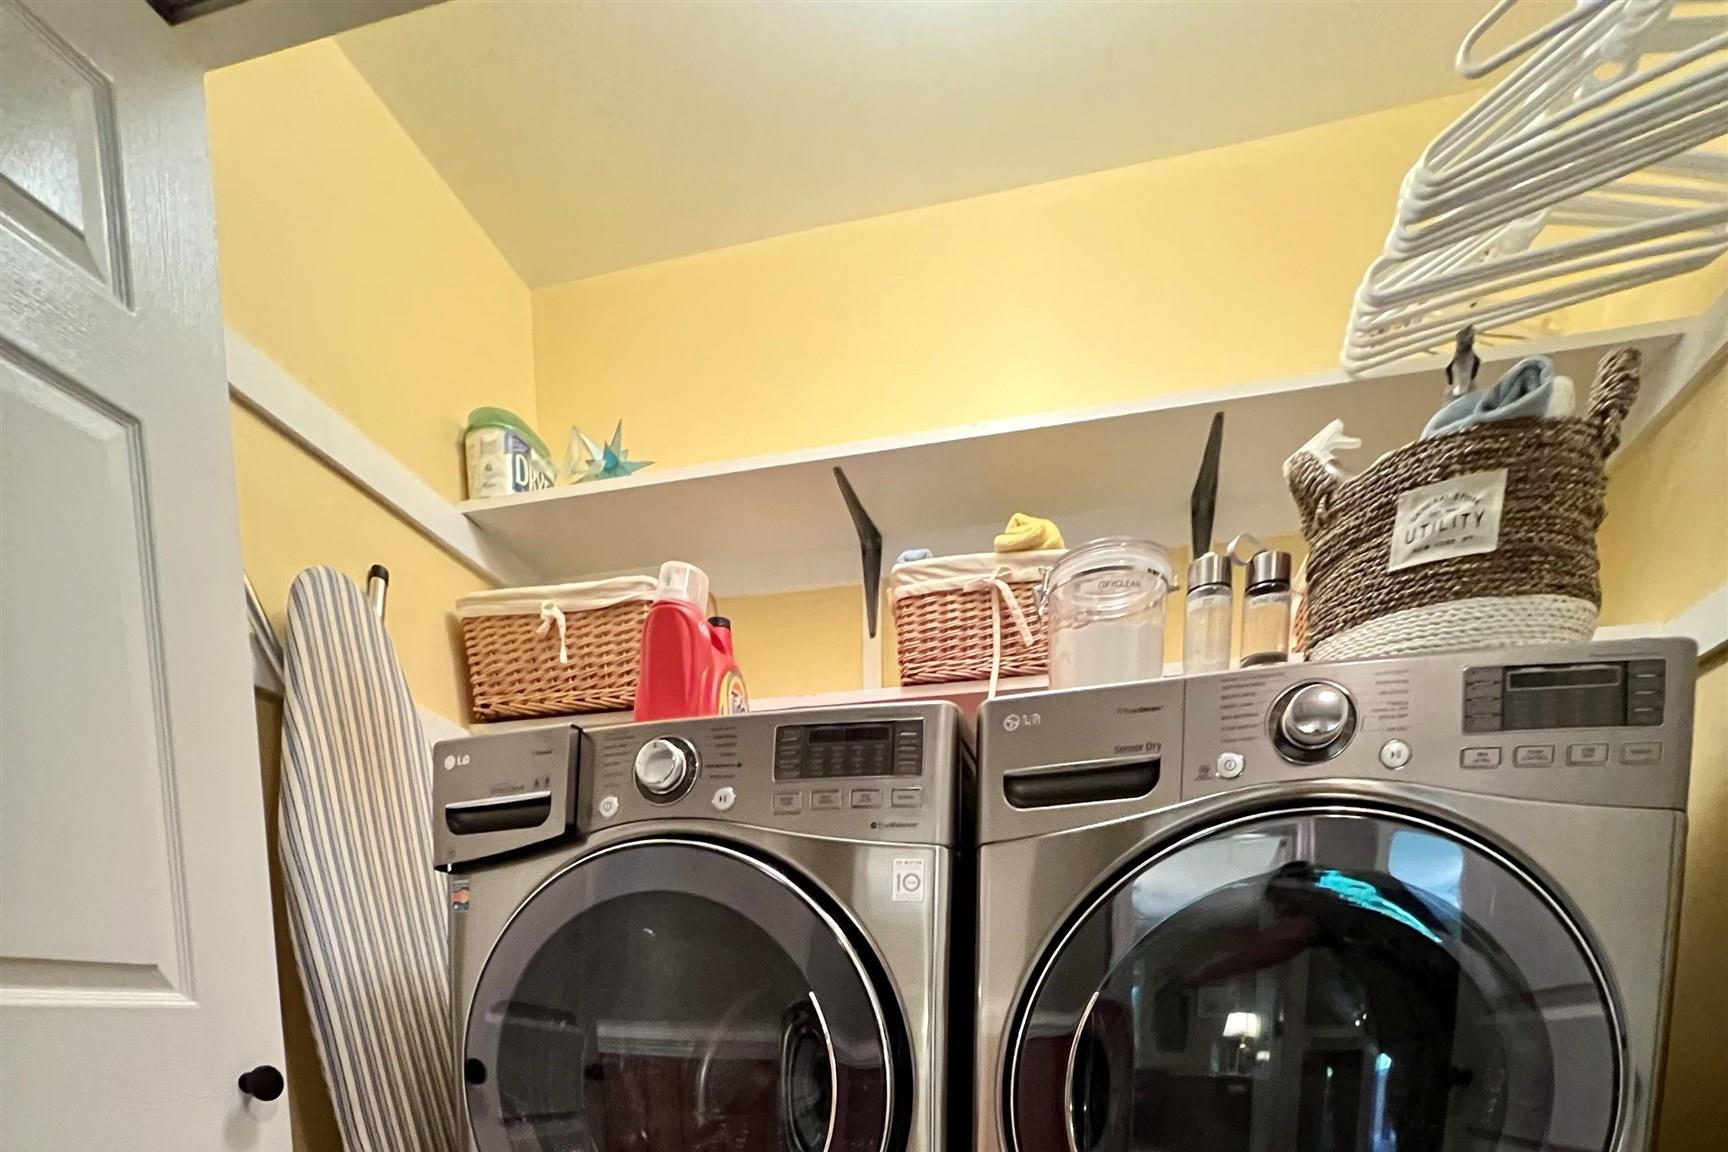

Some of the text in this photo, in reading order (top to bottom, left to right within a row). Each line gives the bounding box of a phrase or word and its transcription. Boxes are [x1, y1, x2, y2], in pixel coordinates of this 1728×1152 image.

[1404, 509, 1485, 545] UTILITY
[1114, 742, 1162, 754] Sensor Dry
